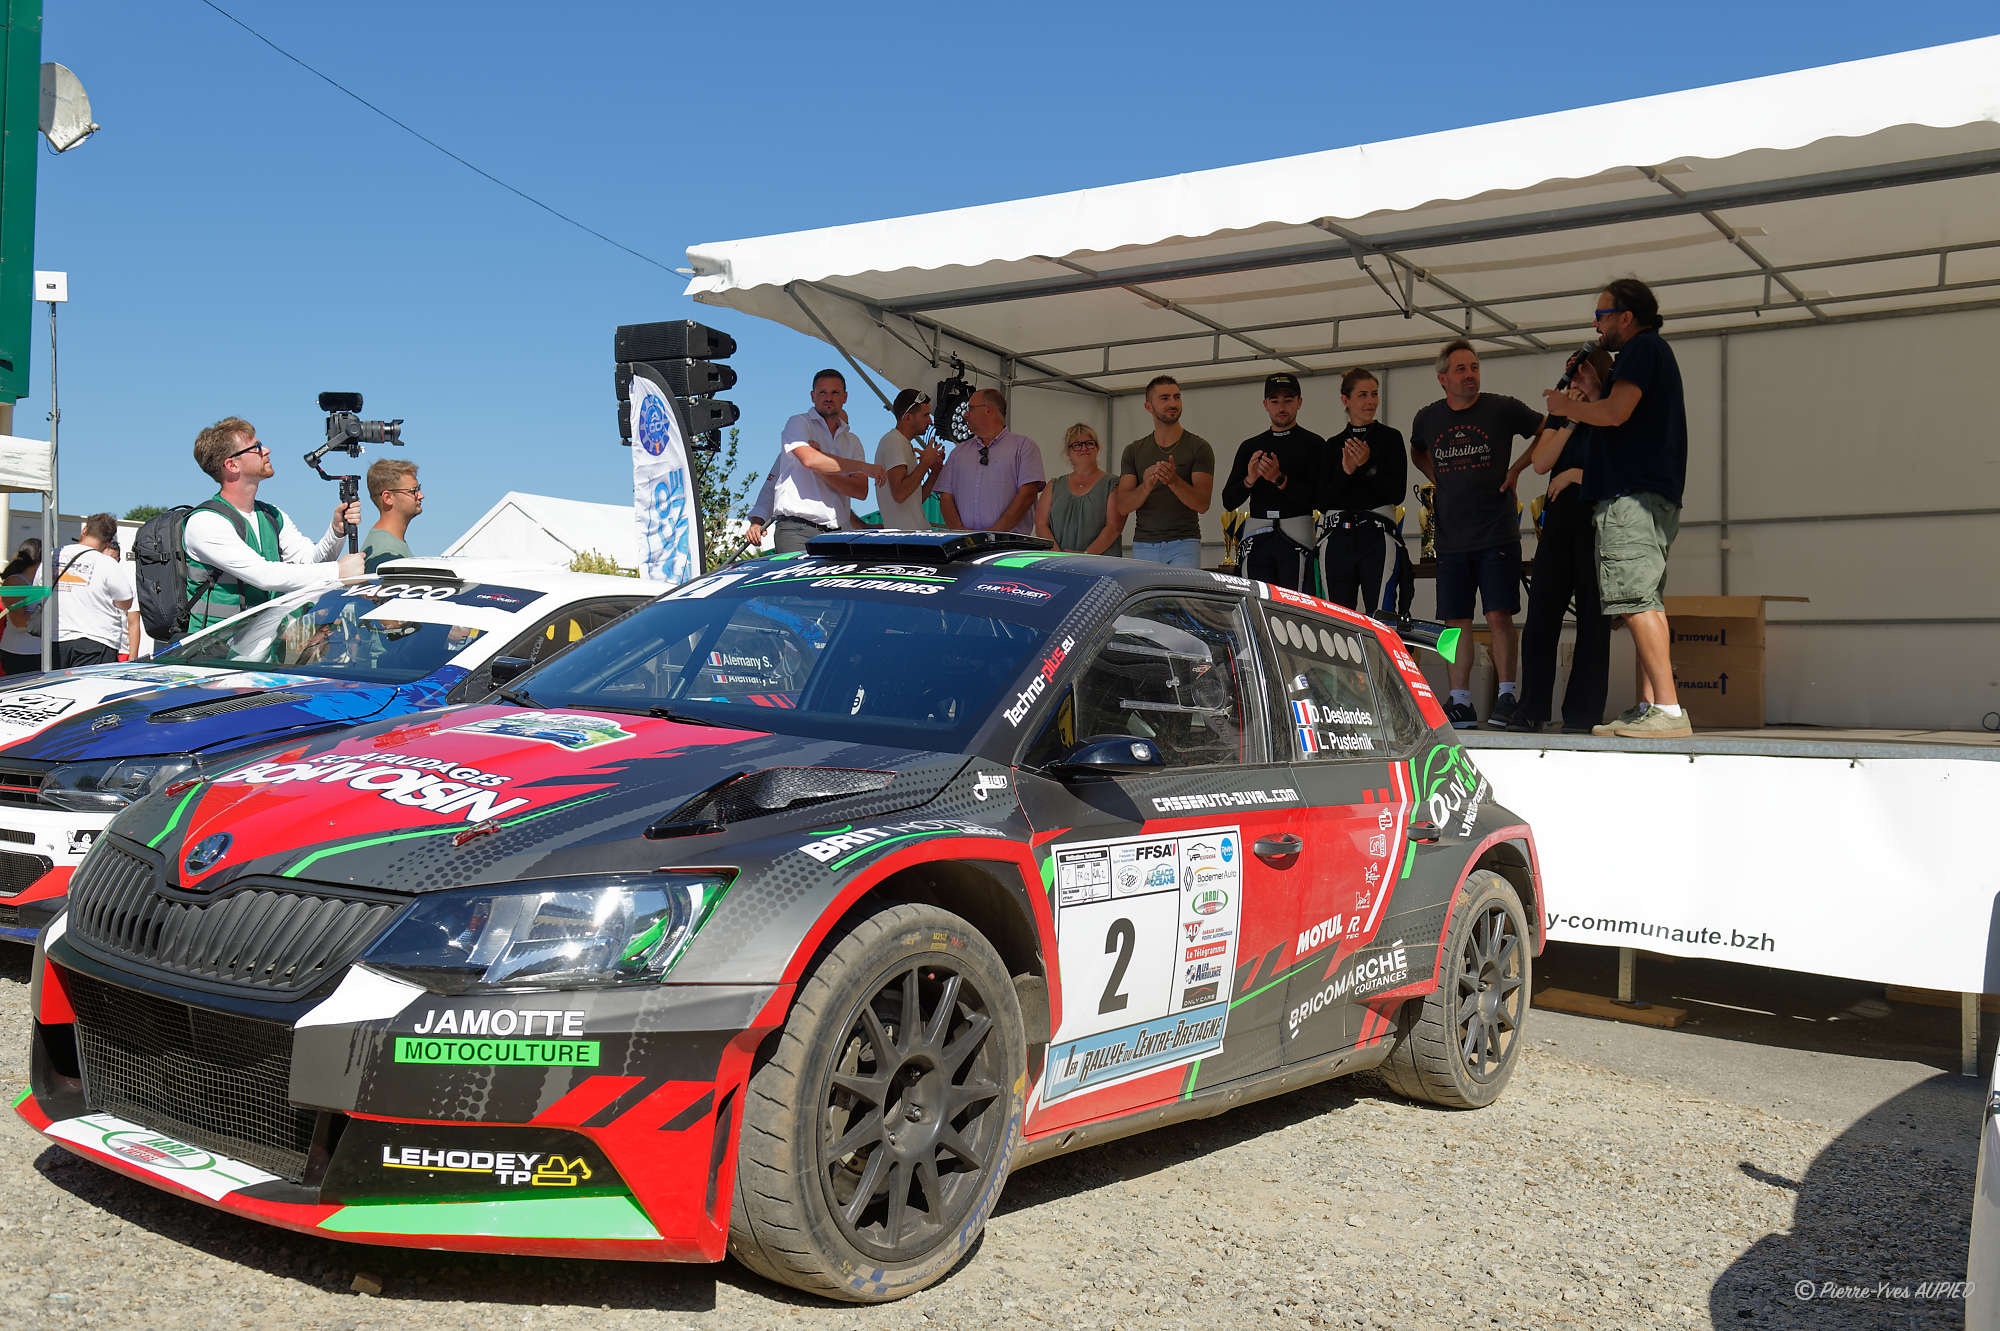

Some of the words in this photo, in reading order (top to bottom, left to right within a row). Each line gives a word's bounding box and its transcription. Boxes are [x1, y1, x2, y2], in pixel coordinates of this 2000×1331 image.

[1434, 444, 1491, 460] Quiksilver
[340, 584, 456, 601] YACCO
[810, 578, 946, 595] UTILITAIRES
[722, 653, 761, 670] Alemany
[762, 655, 773, 668] S.
[1003, 634, 1076, 728] Techno-plus.eu
[1678, 681, 1719, 689] FRAGILE
[1311, 705, 1322, 724] D.
[1324, 705, 1373, 726] Deslandes
[1318, 733, 1329, 750] L.
[1330, 732, 1375, 751] Pustelnik
[798, 827, 891, 863] BRIT
[1135, 844, 1172, 861] FFSA
[1187, 923, 1199, 938] AD
[1296, 913, 1344, 956] MOTUL
[1345, 932, 1360, 940] TEC
[1186, 950, 1194, 959] Le
[1194, 945, 1225, 958] Télégramme
[1097, 917, 1136, 1016] 2
[1289, 938, 1409, 1031] BRICOMARCHÉ
[1355, 968, 1408, 995] COUTANCES
[413, 1009, 586, 1037] JAMOTTE
[405, 1041, 591, 1063] MOTOCULTURE
[1079, 1042, 1127, 1083] RALLYE
[1133, 1016, 1224, 1059] CENTRE-BRETAGNE
[382, 1146, 541, 1171] LEHODEY
[495, 1170, 533, 1186] TP
